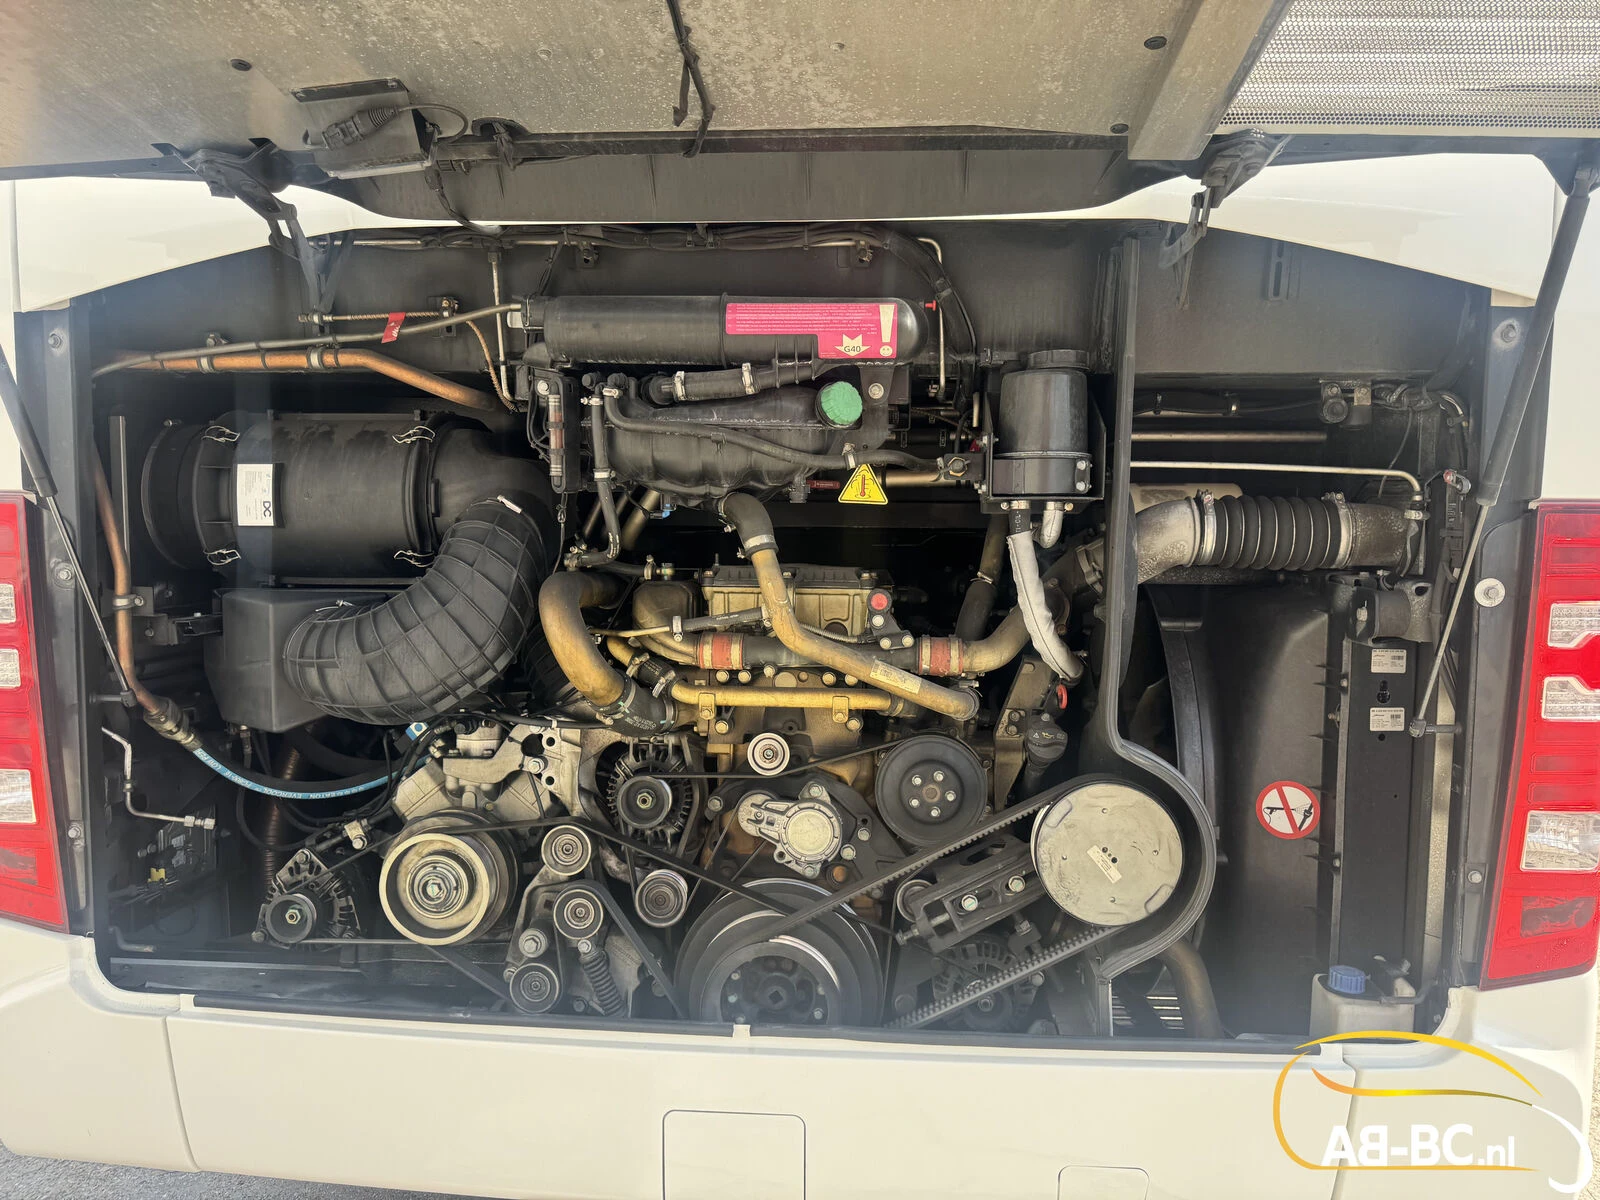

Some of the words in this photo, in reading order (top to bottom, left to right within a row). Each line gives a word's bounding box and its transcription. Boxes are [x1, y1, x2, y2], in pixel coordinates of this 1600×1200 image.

[843, 345, 861, 353] G40
[263, 786, 302, 799] EVERCOOL
[309, 790, 336, 799] EATON
